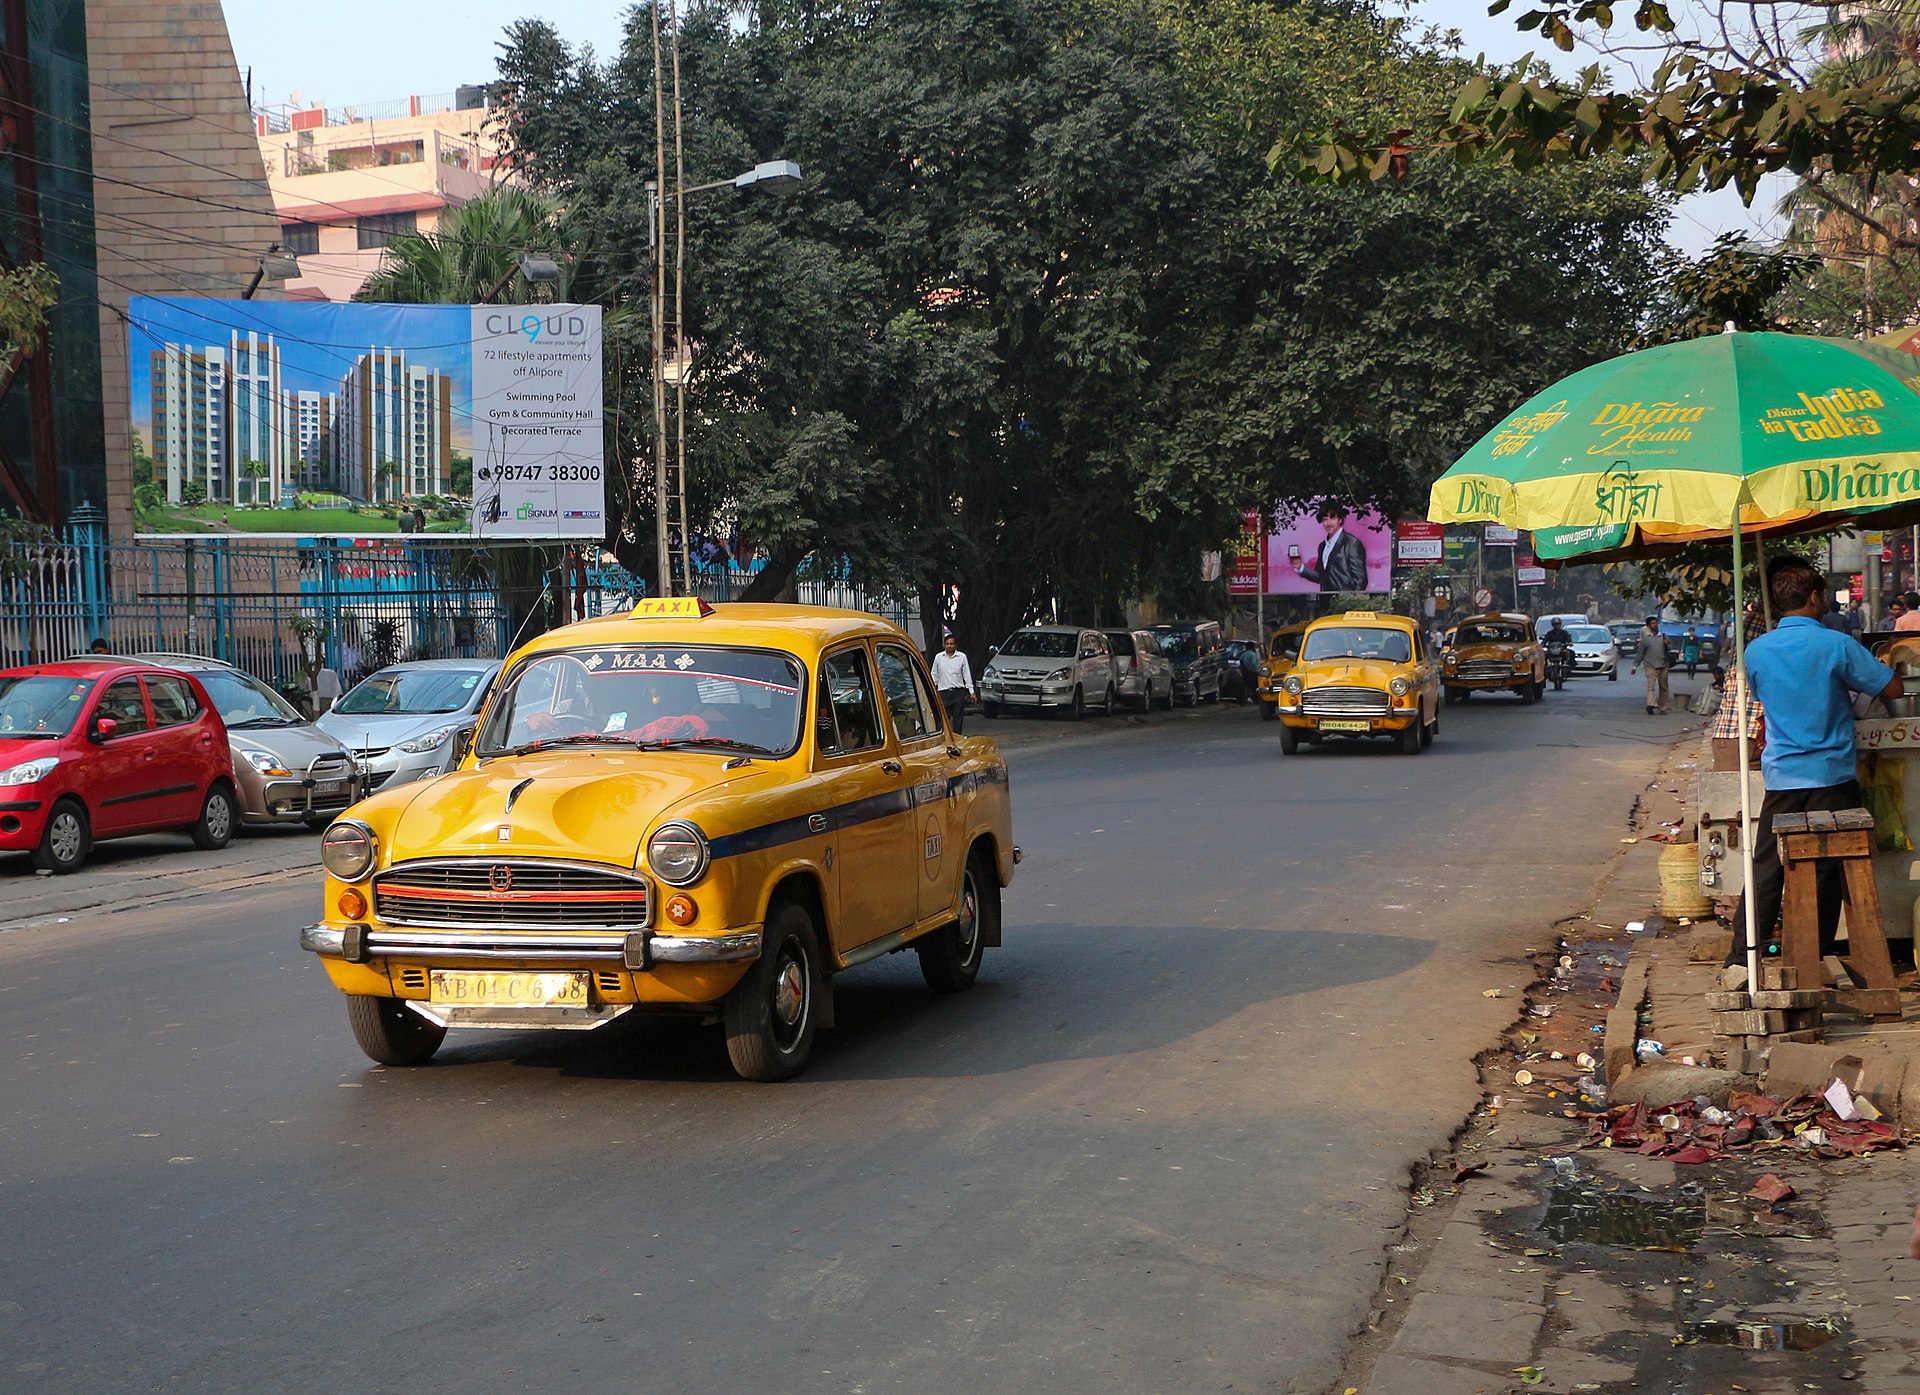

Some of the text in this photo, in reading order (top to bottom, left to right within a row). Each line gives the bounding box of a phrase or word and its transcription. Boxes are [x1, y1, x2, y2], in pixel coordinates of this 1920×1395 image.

[484, 350, 592, 362] 72 lifestyle apartments
[513, 367, 563, 378] off Alipore
[506, 392, 576, 403] Swimming Pool
[1797, 387, 1885, 415] India
[489, 409, 593, 419] Gym & Community Hall
[501, 426, 582, 435] Decorated Terrace
[1759, 415, 1882, 442] ka tadka
[1587, 423, 1693, 454] Health
[495, 465, 600, 480] 98747 38300
[528, 509, 558, 518] SIGNUM
[643, 602, 691, 613] TAXI
[611, 653, 667, 669] MAA
[927, 836, 941, 857] TAXI
